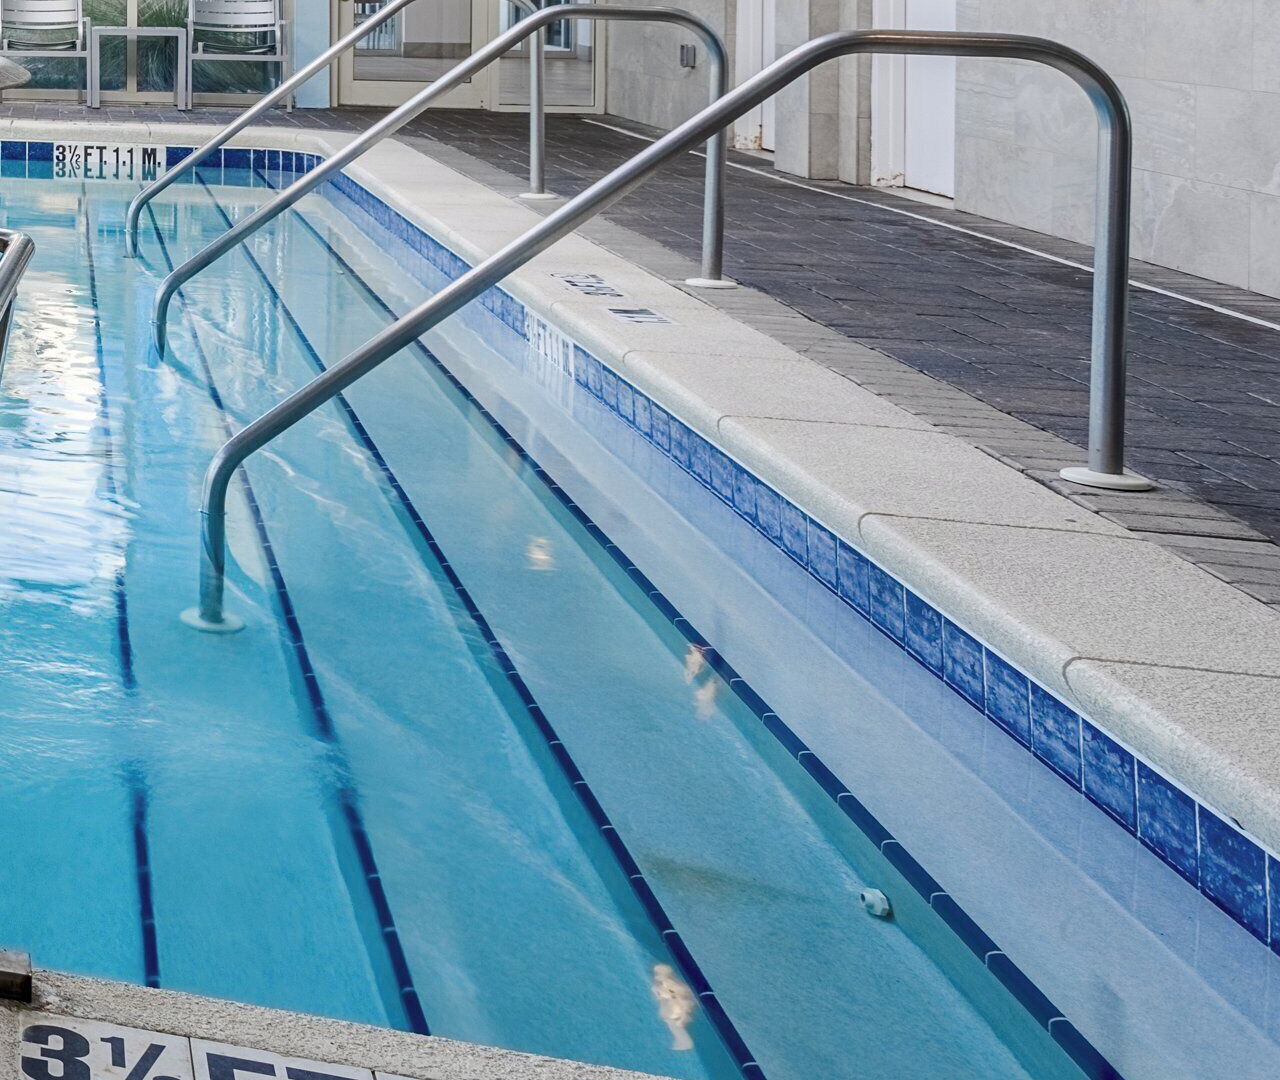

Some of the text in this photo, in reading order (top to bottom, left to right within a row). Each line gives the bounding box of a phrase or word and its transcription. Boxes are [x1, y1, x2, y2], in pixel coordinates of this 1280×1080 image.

[83, 145, 107, 165] FT.
[113, 147, 134, 166] 1.1
[141, 147, 162, 166] M.
